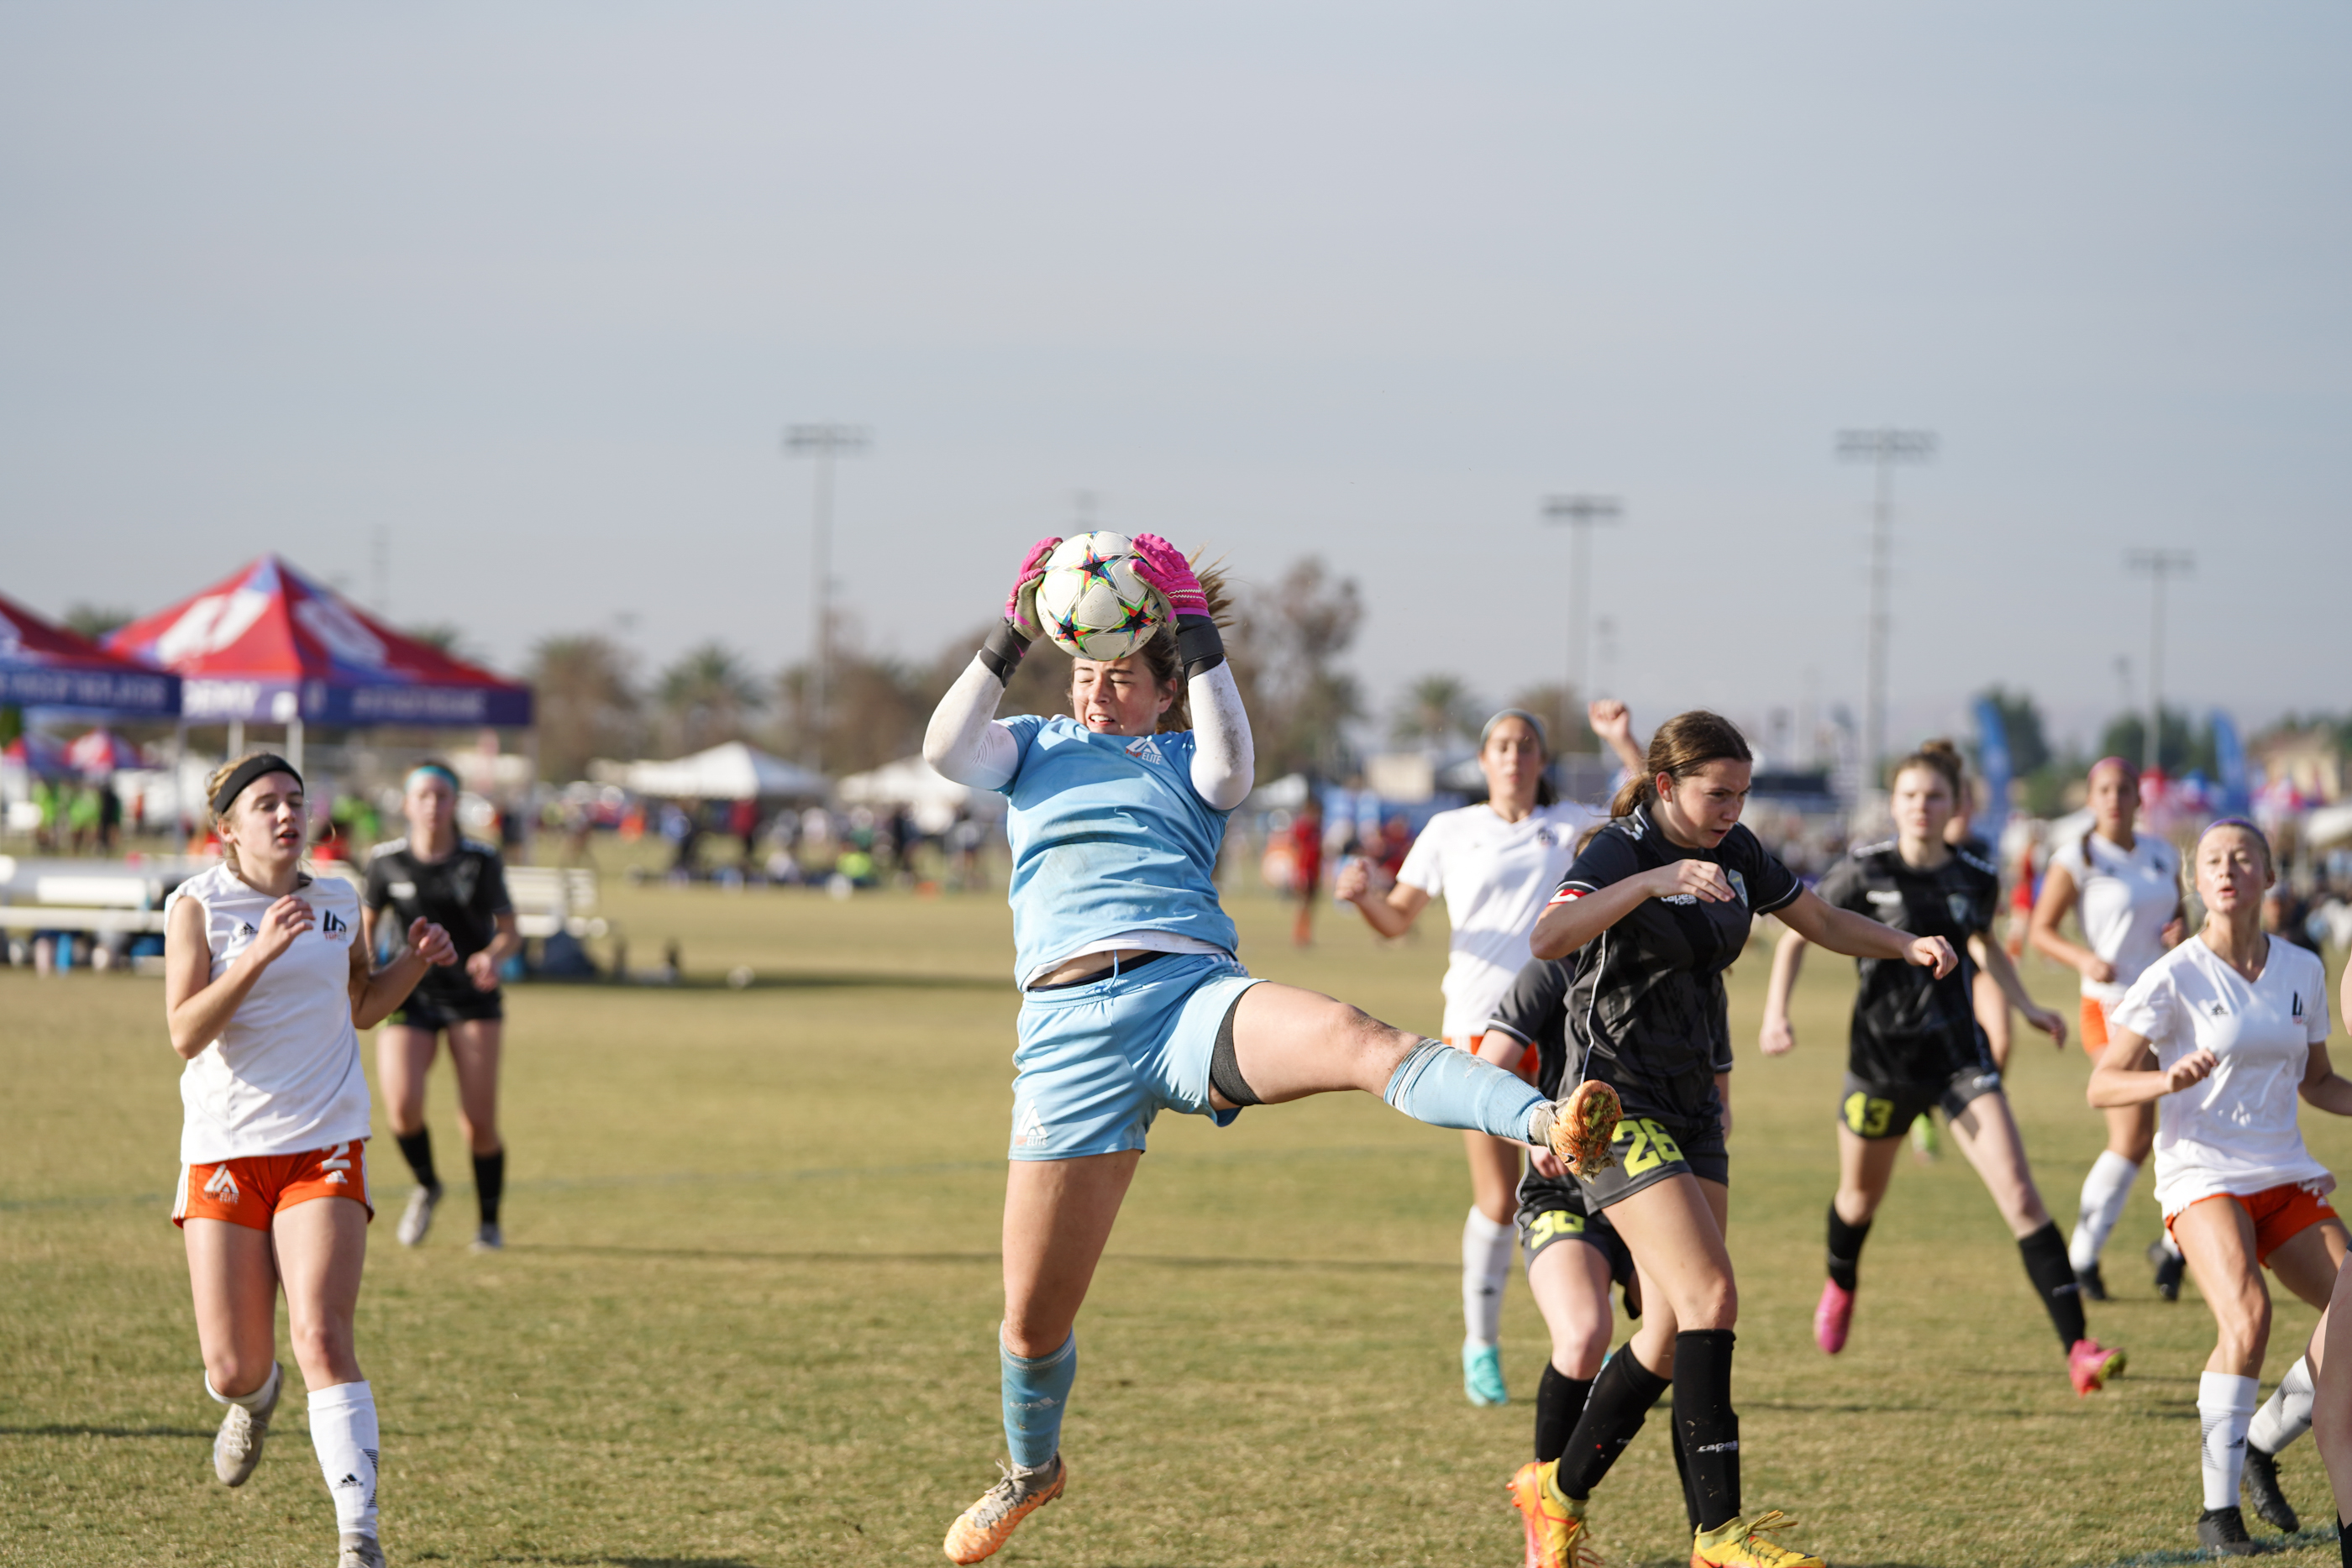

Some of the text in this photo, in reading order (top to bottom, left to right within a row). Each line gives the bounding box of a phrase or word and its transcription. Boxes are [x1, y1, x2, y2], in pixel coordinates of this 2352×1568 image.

[1142, 752, 1163, 765] ELITE
[1026, 1135, 1047, 1146] ELITE
[1611, 1118, 1685, 1177] 26
